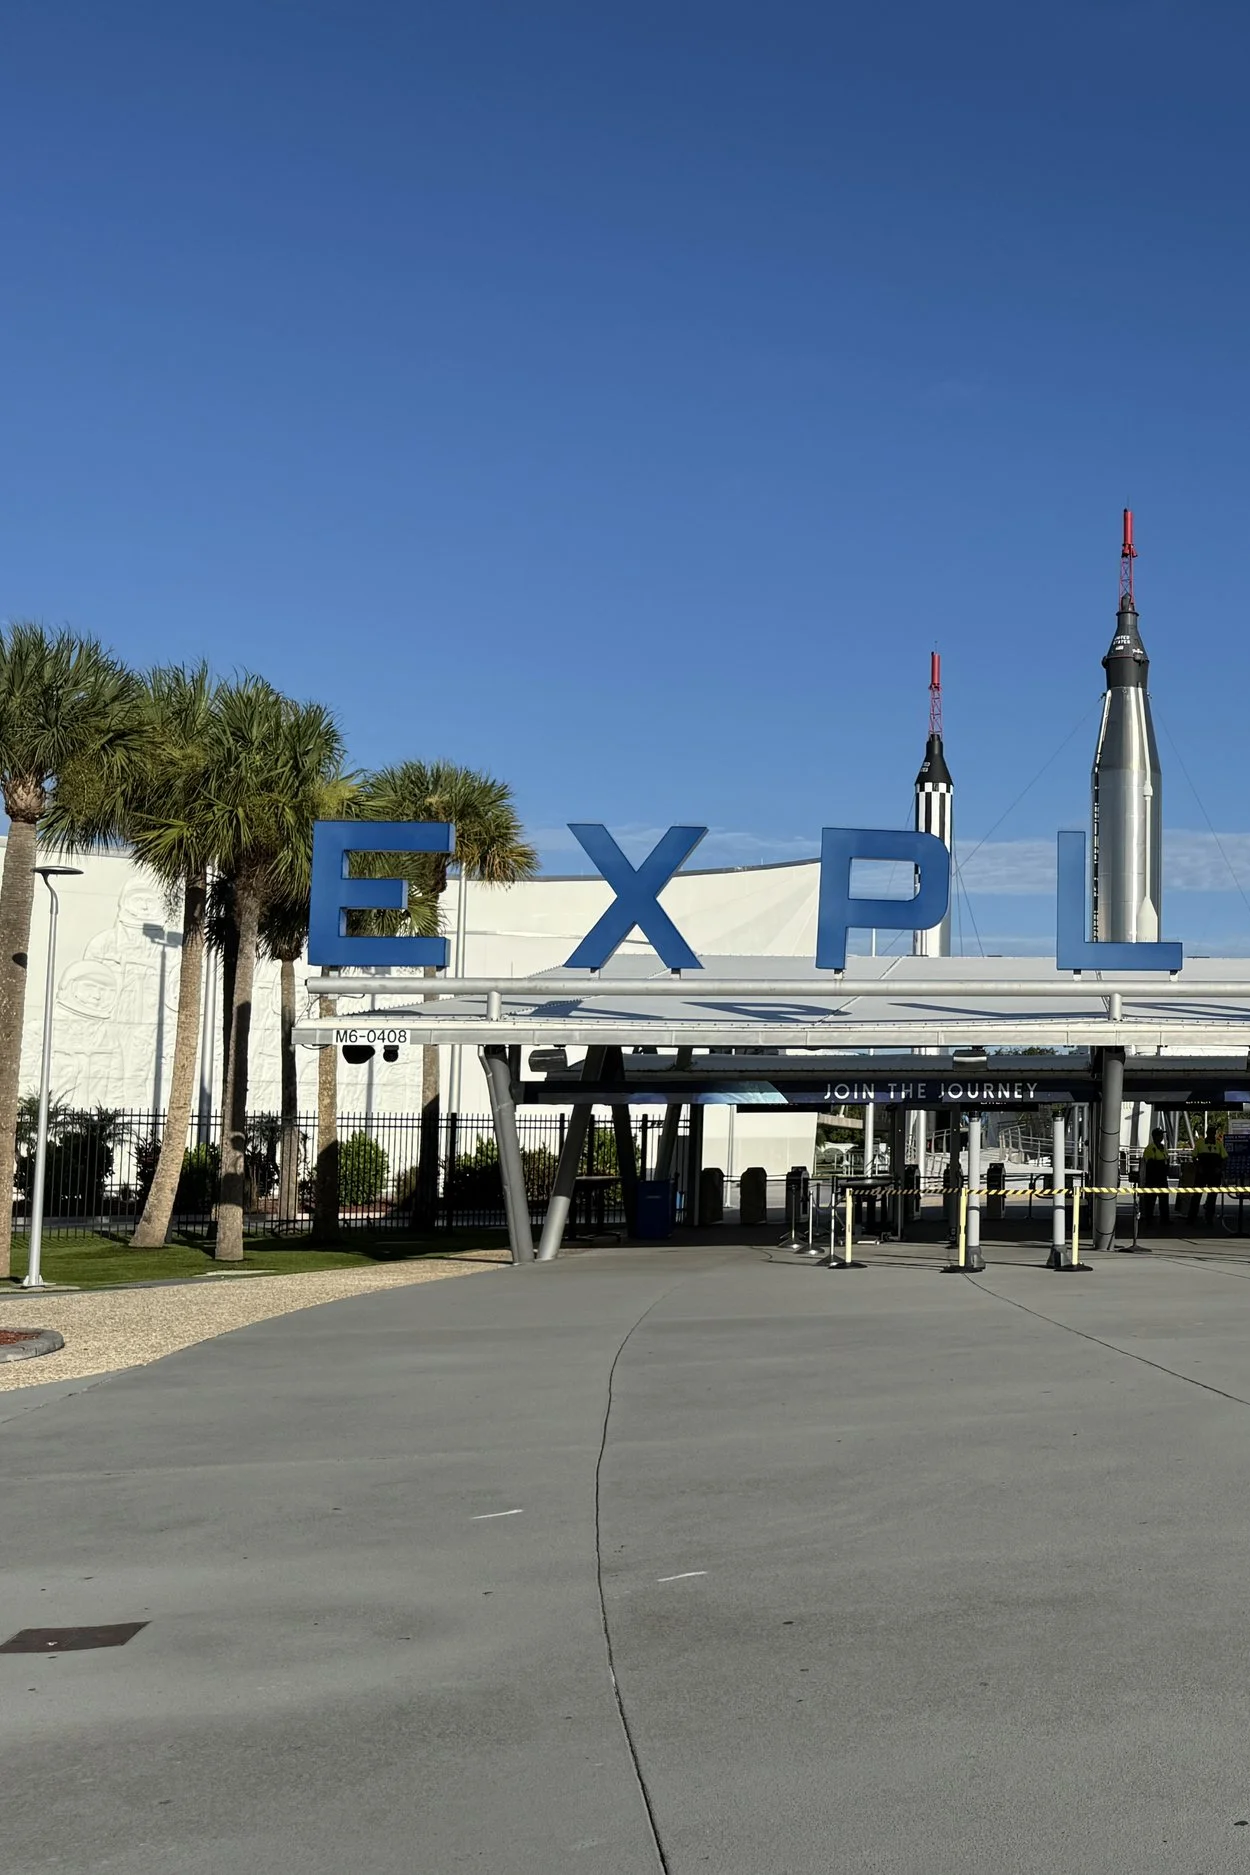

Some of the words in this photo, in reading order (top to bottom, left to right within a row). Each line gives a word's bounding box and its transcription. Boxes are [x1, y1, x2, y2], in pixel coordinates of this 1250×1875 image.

[335, 1029, 407, 1043] M6-0408
[823, 1083, 875, 1100] JOIN
[887, 1083, 927, 1099] THE
[938, 1082, 1038, 1100] JOURNEY
